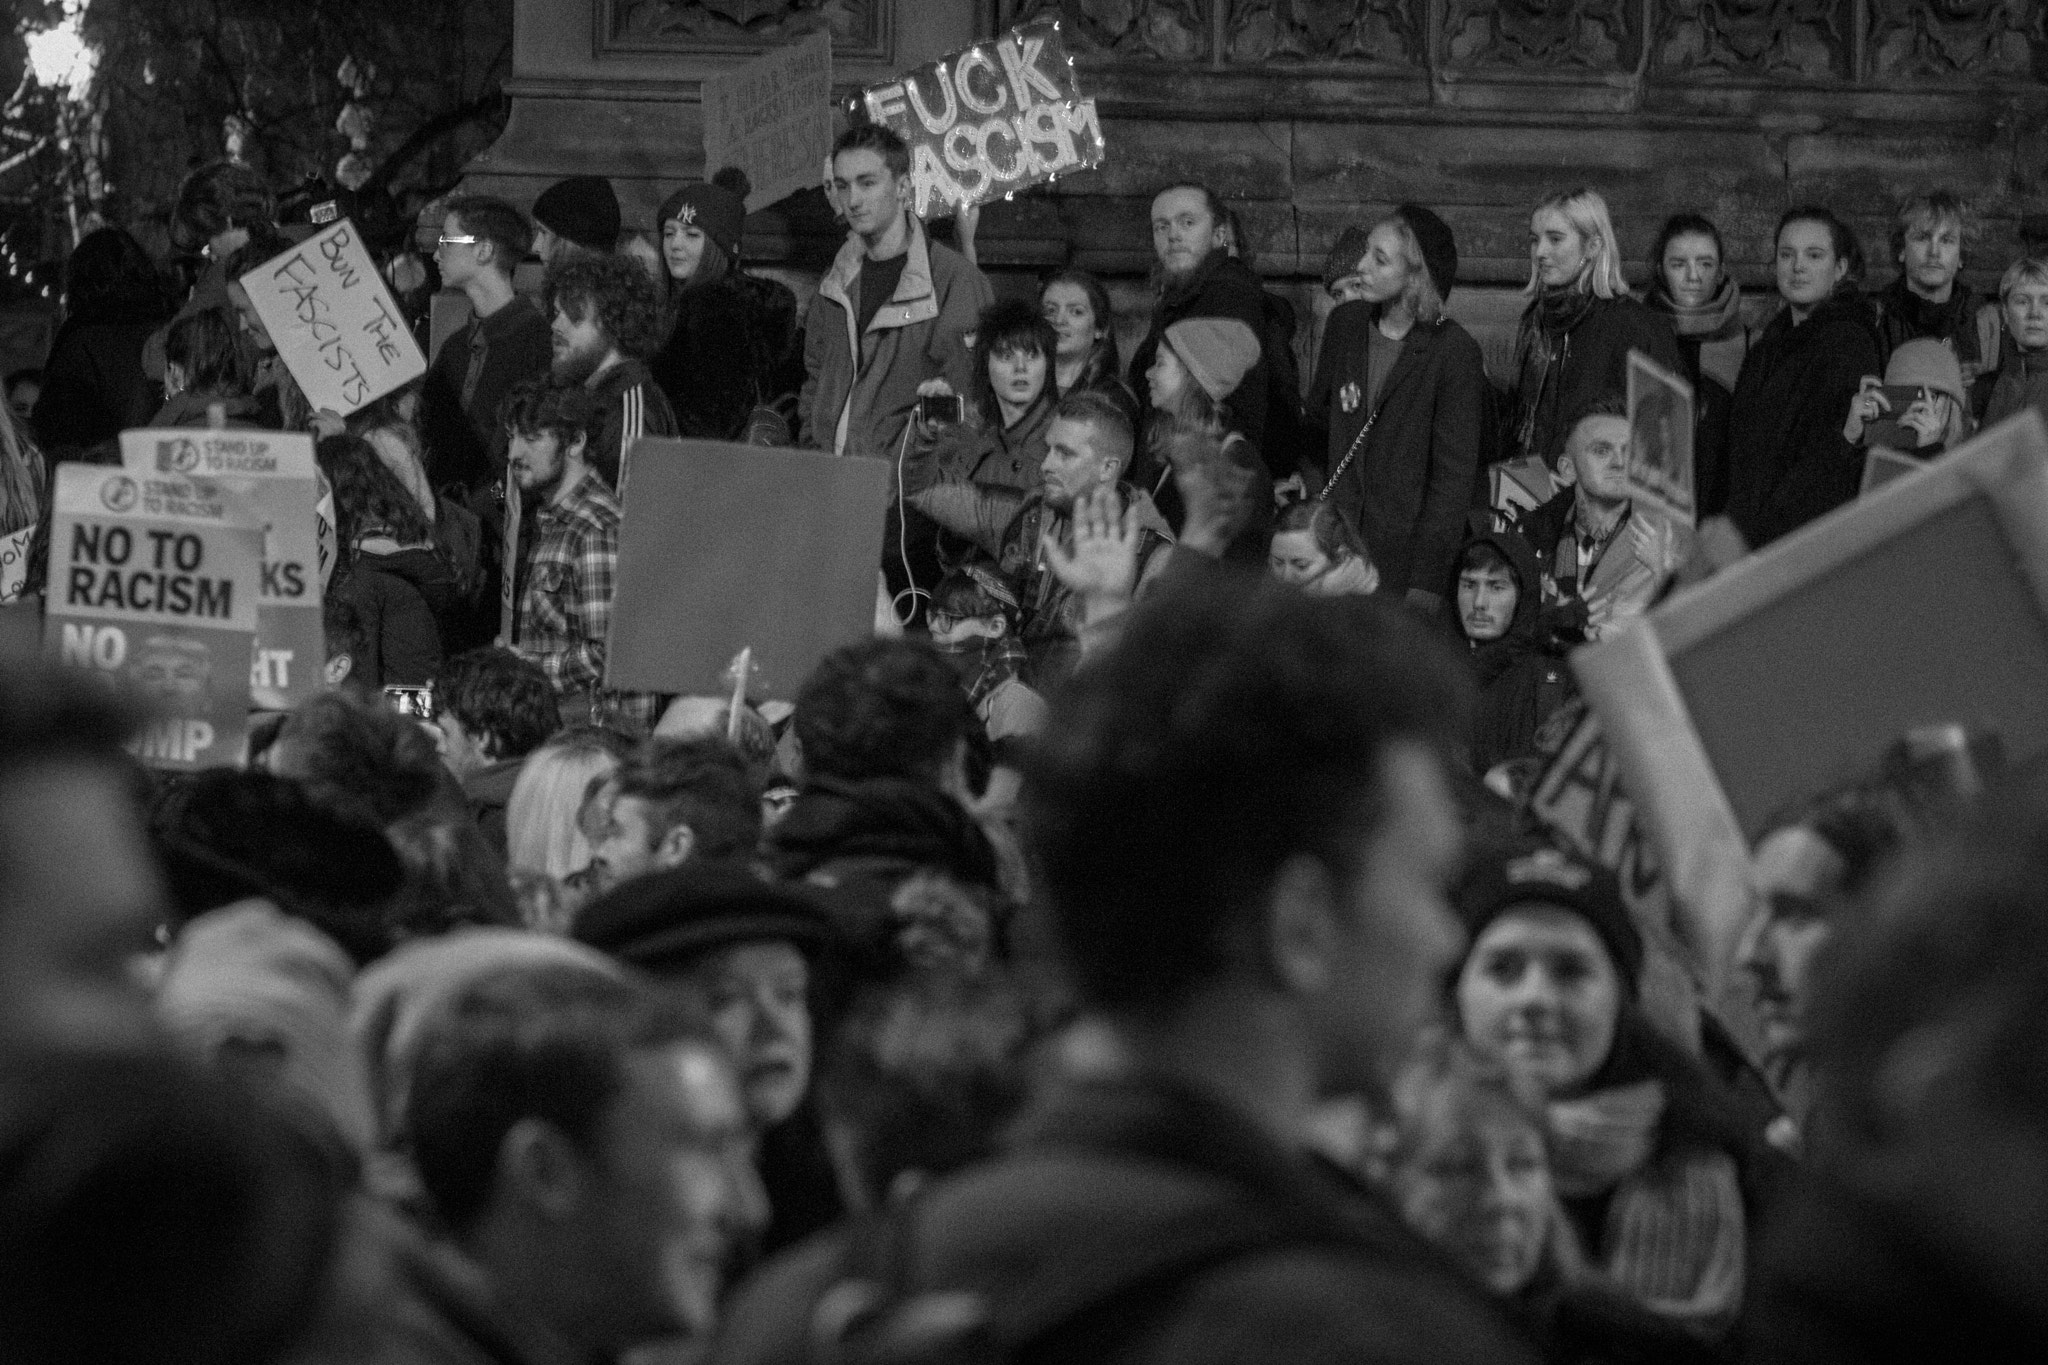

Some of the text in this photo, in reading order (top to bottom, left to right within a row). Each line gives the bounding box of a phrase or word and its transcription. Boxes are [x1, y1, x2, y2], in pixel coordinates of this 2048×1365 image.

[864, 36, 1062, 135] FUCK
[273, 253, 370, 406] FASCISTS
[362, 296, 401, 366] THE
[70, 522, 204, 573] NO TO
[67, 566, 234, 620] RACISM
[61, 622, 127, 670] NO
